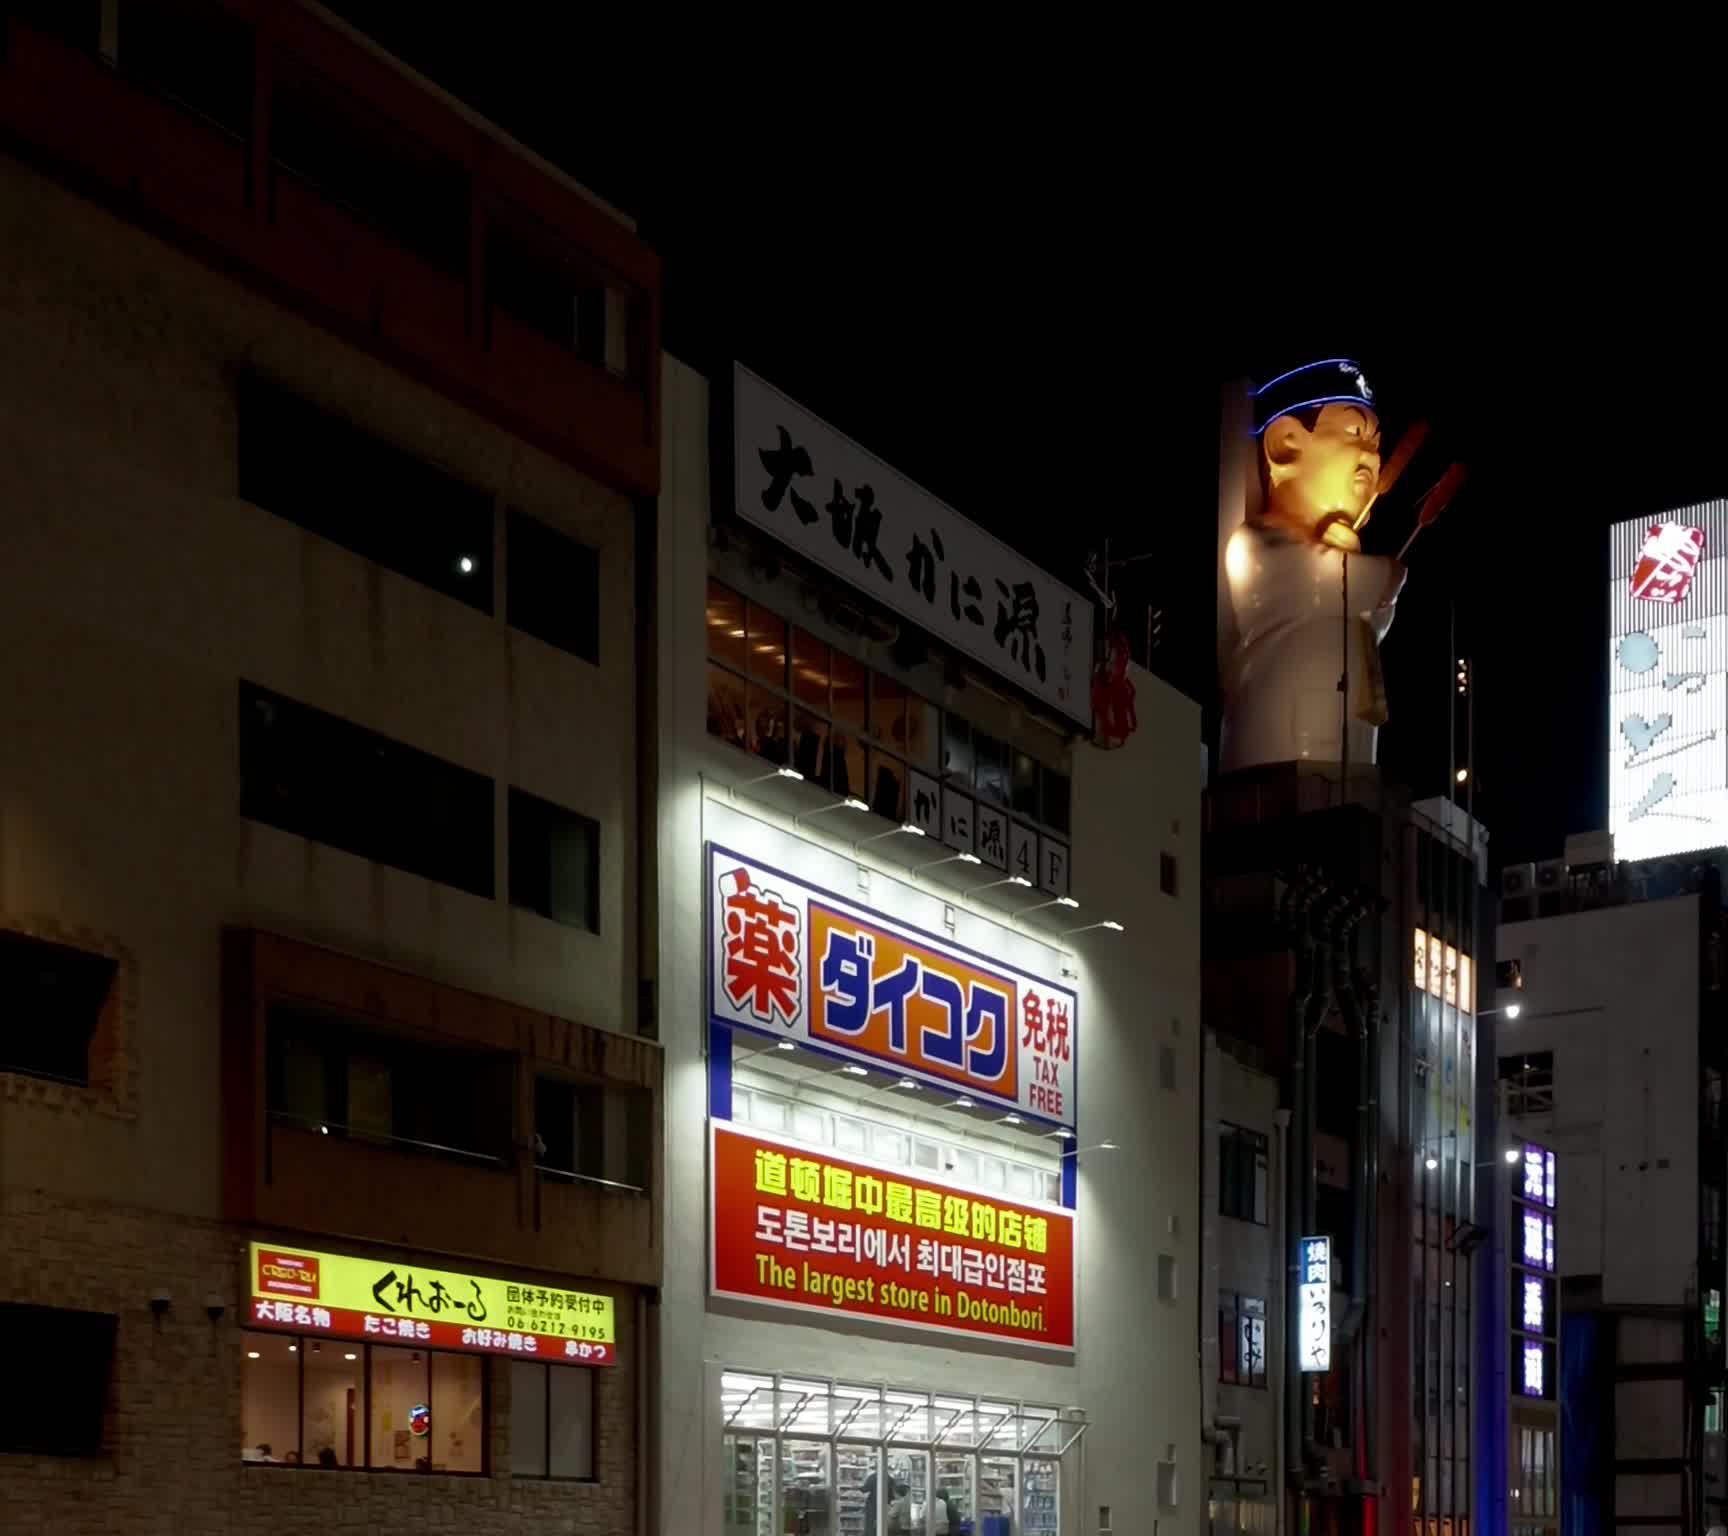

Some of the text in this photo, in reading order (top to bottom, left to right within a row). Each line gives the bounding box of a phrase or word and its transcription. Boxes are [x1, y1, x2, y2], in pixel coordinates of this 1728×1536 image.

[723, 866, 800, 1024] 薬
[820, 926, 1009, 1082] ダイコク
[1022, 988, 1070, 1062] 免税
[1033, 1055, 1059, 1087] TAX
[1029, 1082, 1063, 1116] FREE
[755, 1204, 1048, 1294] 도톤보리에서 최대급인점포
[1307, 1241, 1328, 1283] 焼肉
[372, 1270, 487, 1322] くれおーる
[506, 1285, 605, 1316] 団体予約受付中
[755, 1254, 1048, 1333] The largest store in Dotonbori.
[255, 1301, 331, 1328] 大阪名物
[363, 1315, 431, 1340] たこ焼き
[461, 1327, 538, 1352] お好み焼き
[507, 1316, 606, 1340] 06 6212 9195
